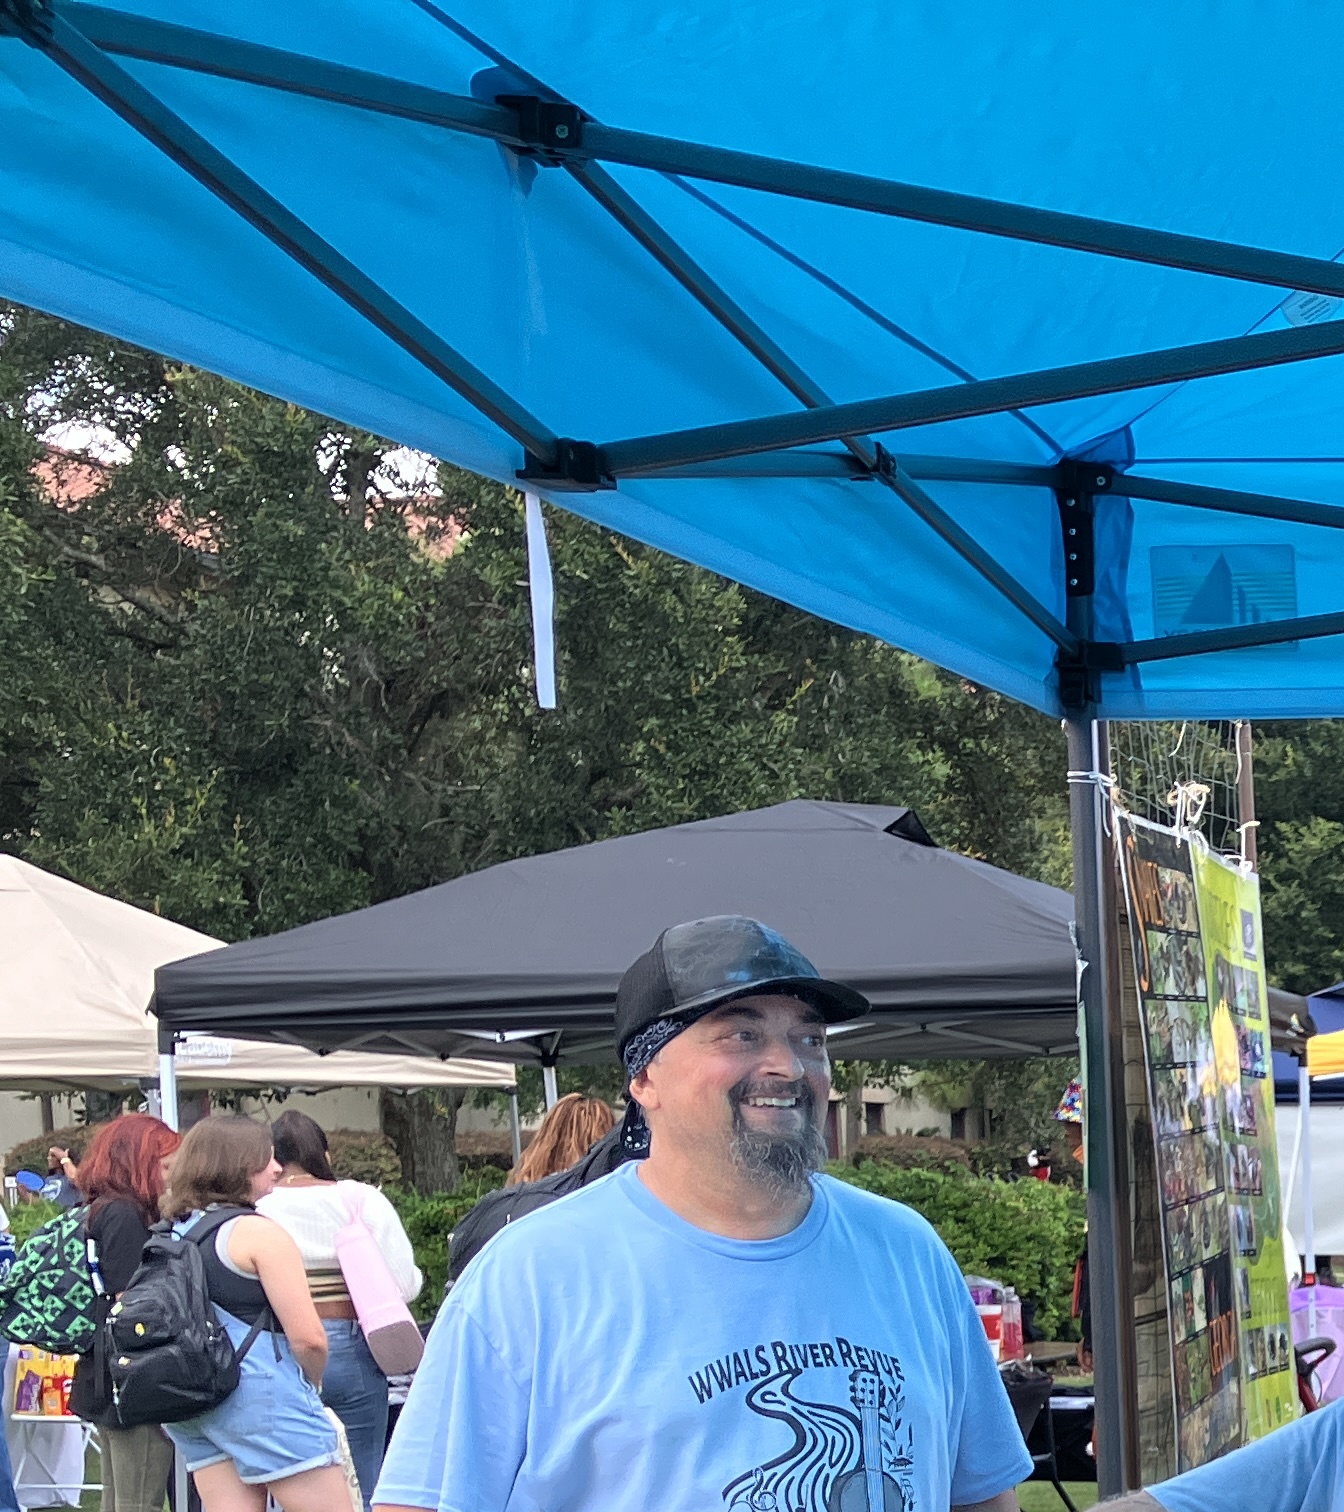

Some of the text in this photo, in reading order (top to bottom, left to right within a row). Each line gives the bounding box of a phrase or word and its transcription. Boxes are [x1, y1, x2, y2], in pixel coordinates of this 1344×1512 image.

[688, 1337, 905, 1405] WWALS RIVER REVUE
